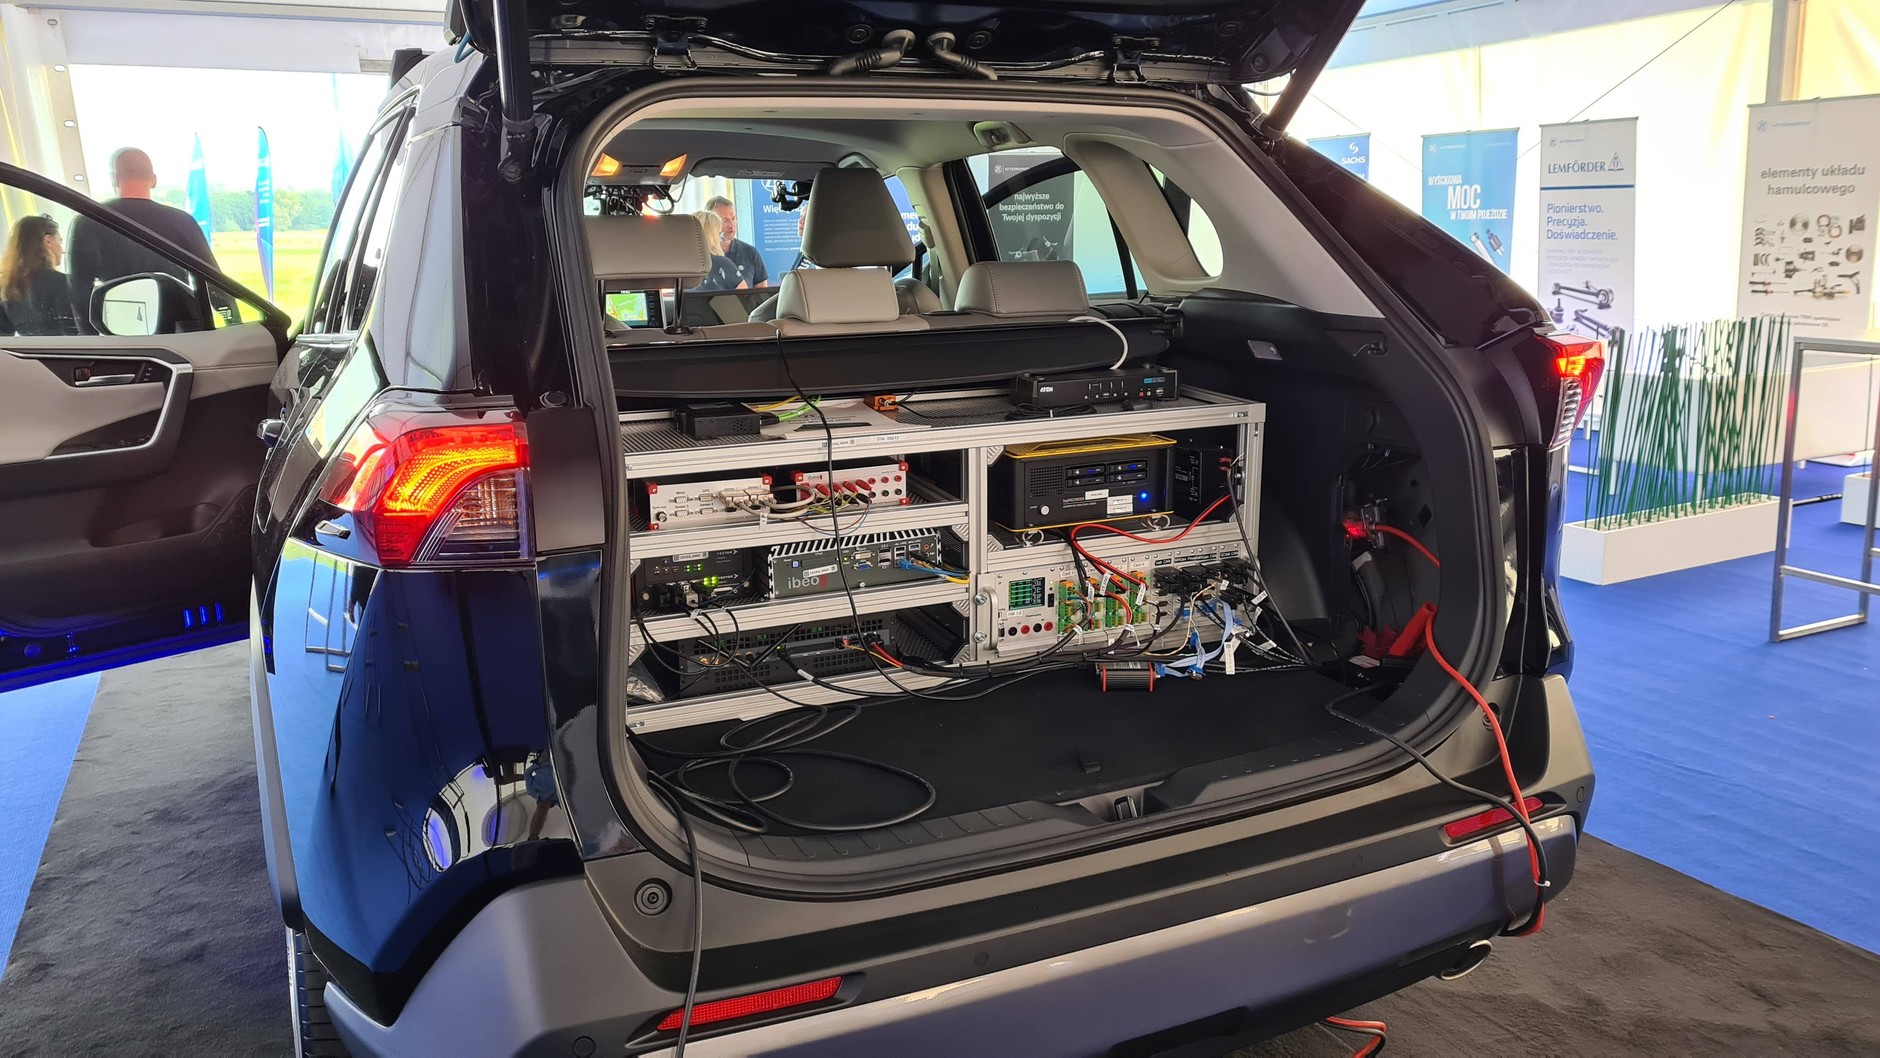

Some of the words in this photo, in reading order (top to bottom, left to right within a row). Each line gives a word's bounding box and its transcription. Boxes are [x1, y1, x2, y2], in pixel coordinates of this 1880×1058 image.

[1341, 156, 1366, 164] SACHS
[1548, 160, 1606, 174] LEMFÖRDER
[1761, 167, 1818, 180] elementy
[1821, 164, 1866, 177] układu
[1767, 184, 1856, 196] hamulcowego
[1014, 192, 1050, 201] najwyższe
[1447, 184, 1481, 210] MOC
[999, 202, 1053, 212] bezpieczeństwo
[1055, 202, 1064, 210] do
[1547, 203, 1604, 214] Pionierstwo.
[1002, 213, 1024, 222] Twojej
[1026, 212, 1062, 222] dyspozycji
[1450, 211, 1457, 220] W
[1457, 209, 1476, 220] TWOIM
[1547, 216, 1588, 228] Precyzja.
[1546, 228, 1618, 240] Doświadczenie.
[788, 576, 820, 589] ibeo
